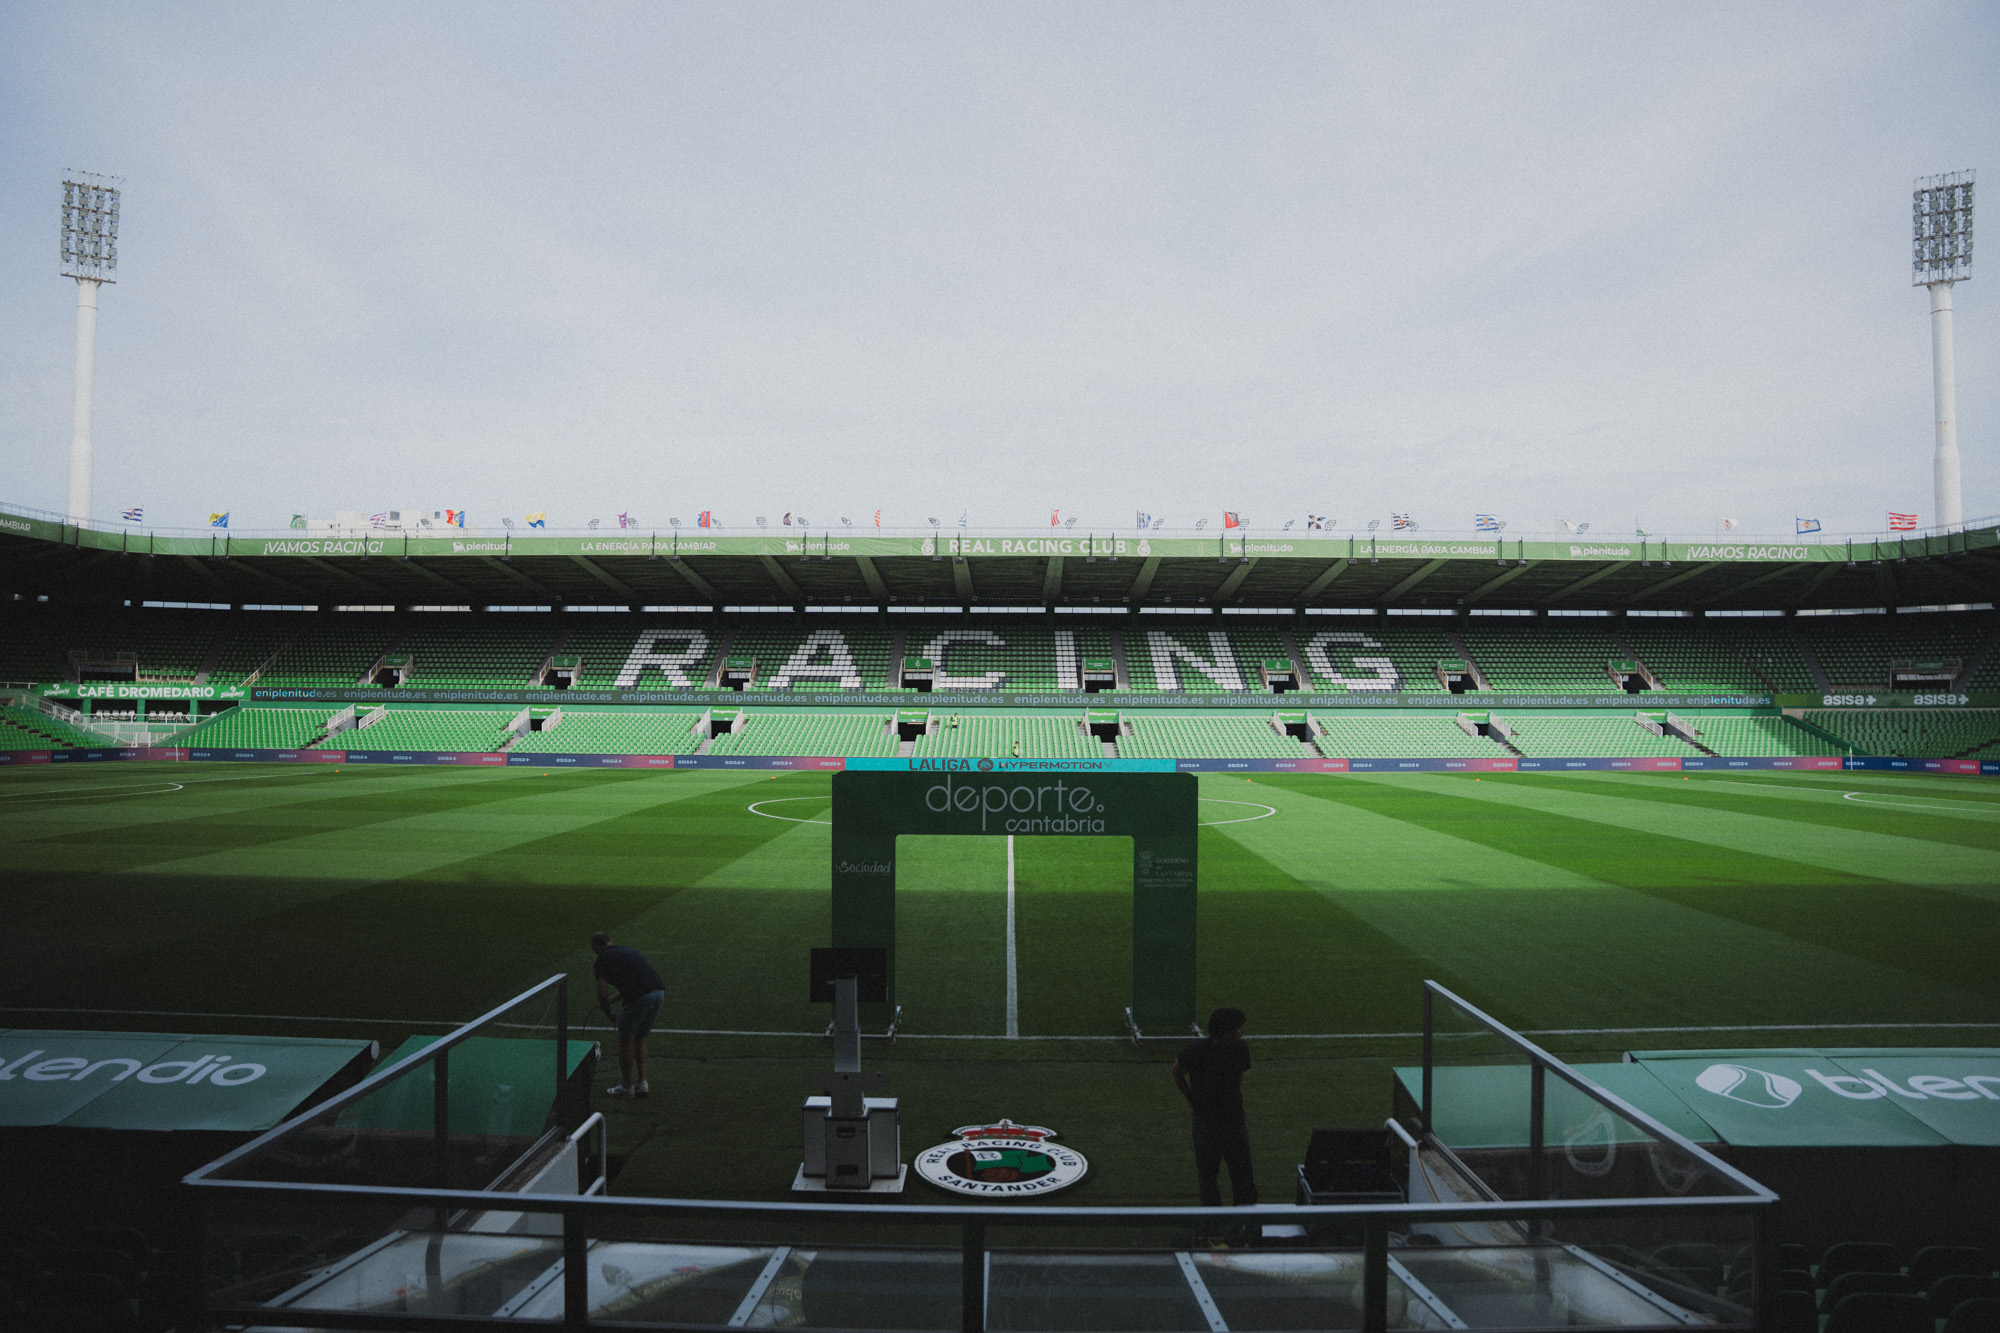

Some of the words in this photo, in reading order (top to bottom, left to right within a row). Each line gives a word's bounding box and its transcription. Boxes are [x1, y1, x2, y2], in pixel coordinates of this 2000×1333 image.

[264, 541, 320, 555] ¡VAMOS
[323, 541, 384, 554] RACING!
[466, 542, 512, 553] plenitude
[581, 542, 594, 551] LA
[596, 540, 638, 551] ENERGÍA
[642, 542, 668, 551] PARA
[671, 542, 716, 551] CAMBIAR
[800, 541, 850, 552] plenitude
[949, 540, 995, 554] REAL
[1002, 540, 1072, 554] RACING
[1080, 540, 1126, 554] CLUB
[1245, 544, 1293, 554] plenitude
[1360, 545, 1373, 554] LA
[1376, 544, 1418, 554] ENERGÍA
[1421, 546, 1448, 554] PARA
[1450, 546, 1496, 555] CAMBIAR
[1583, 546, 1630, 557] plenitude
[1686, 547, 1744, 561] ¡VAMOS
[1748, 547, 1808, 560] RACING!
[613, 629, 1400, 691] RACING
[77, 684, 115, 698] CAFÉ
[118, 686, 215, 698] DROMEDARIO
[256, 687, 336, 700] eniplenitude.es
[344, 688, 426, 700] eniplenitude.es
[434, 690, 518, 702] eniplenitude.es
[526, 691, 612, 703] eniplenitude.es
[622, 692, 710, 704] eniplenitude.es
[718, 692, 806, 704] eniplenitude.es
[815, 694, 905, 705] eniplenitude.es
[913, 694, 1004, 705] eniplenitude.es
[1014, 694, 1106, 706] eniplenitude.es
[1114, 694, 1204, 706] eniplenitude.es
[1212, 695, 1302, 706] eniplenitude.es
[1309, 695, 1398, 706] eniplenitude.es
[1408, 695, 1495, 707] eniplenitude.es
[1502, 695, 1588, 706] eniplenitude.es
[1595, 695, 1680, 706] eniplenitude.es
[1686, 695, 1770, 706] eniplenitude.es
[1823, 694, 1864, 706] asisa
[1914, 694, 1956, 706] asisa
[909, 759, 970, 770] LALIGA
[1006, 814, 1104, 832] cantabria
[926, 1146, 959, 1164] REAL
[962, 1140, 1042, 1149] RACING
[1046, 1148, 1077, 1166] CLUB
[938, 1175, 1062, 1192] SANTANDER
